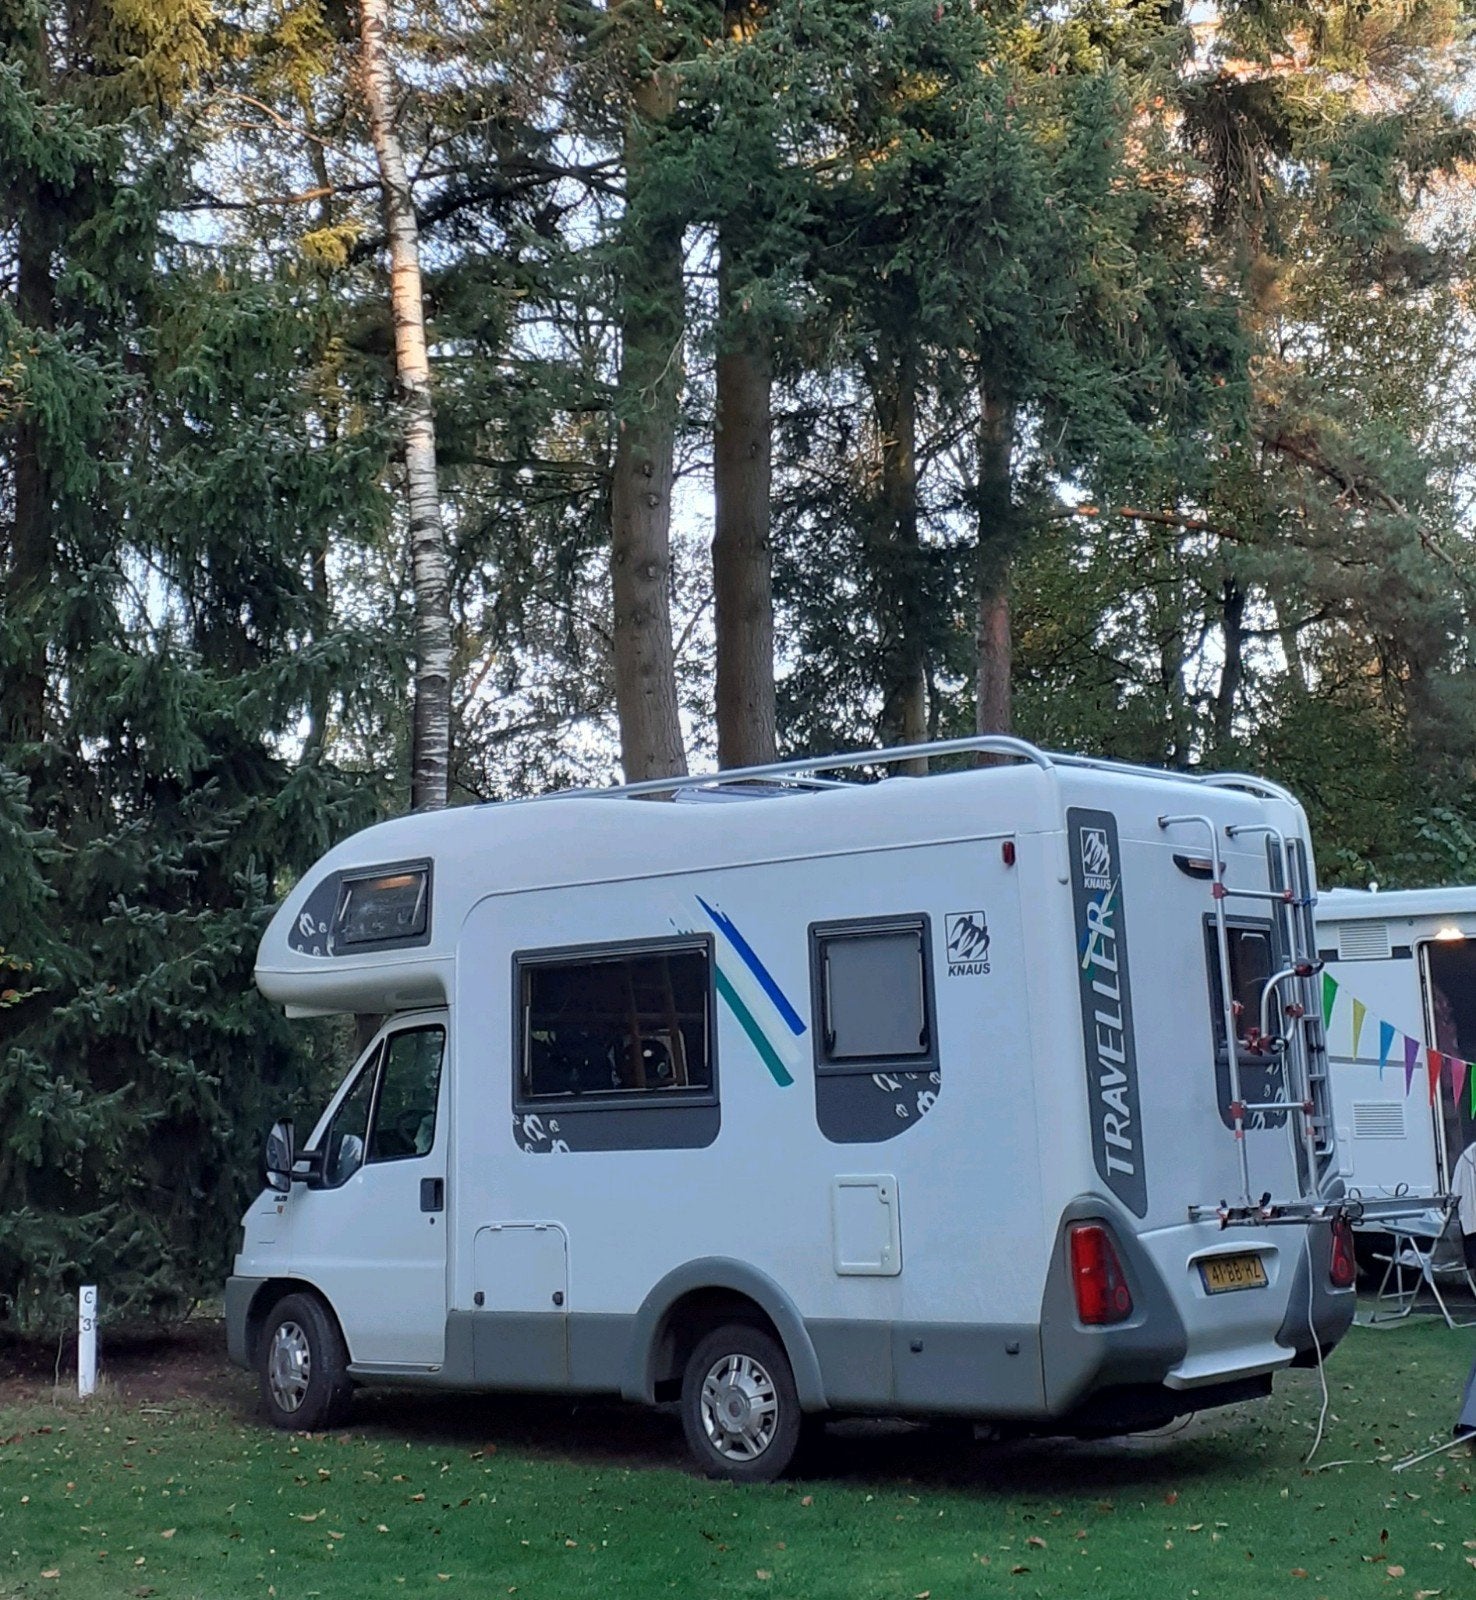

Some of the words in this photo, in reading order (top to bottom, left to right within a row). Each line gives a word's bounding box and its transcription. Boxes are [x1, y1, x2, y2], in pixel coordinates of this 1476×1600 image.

[1084, 877, 1112, 890] KNAUS
[948, 963, 991, 977] KNAUS
[1086, 900, 1134, 1177] TRAVELLER
[84, 1291, 93, 1304] C
[83, 1318, 92, 1331] 3
